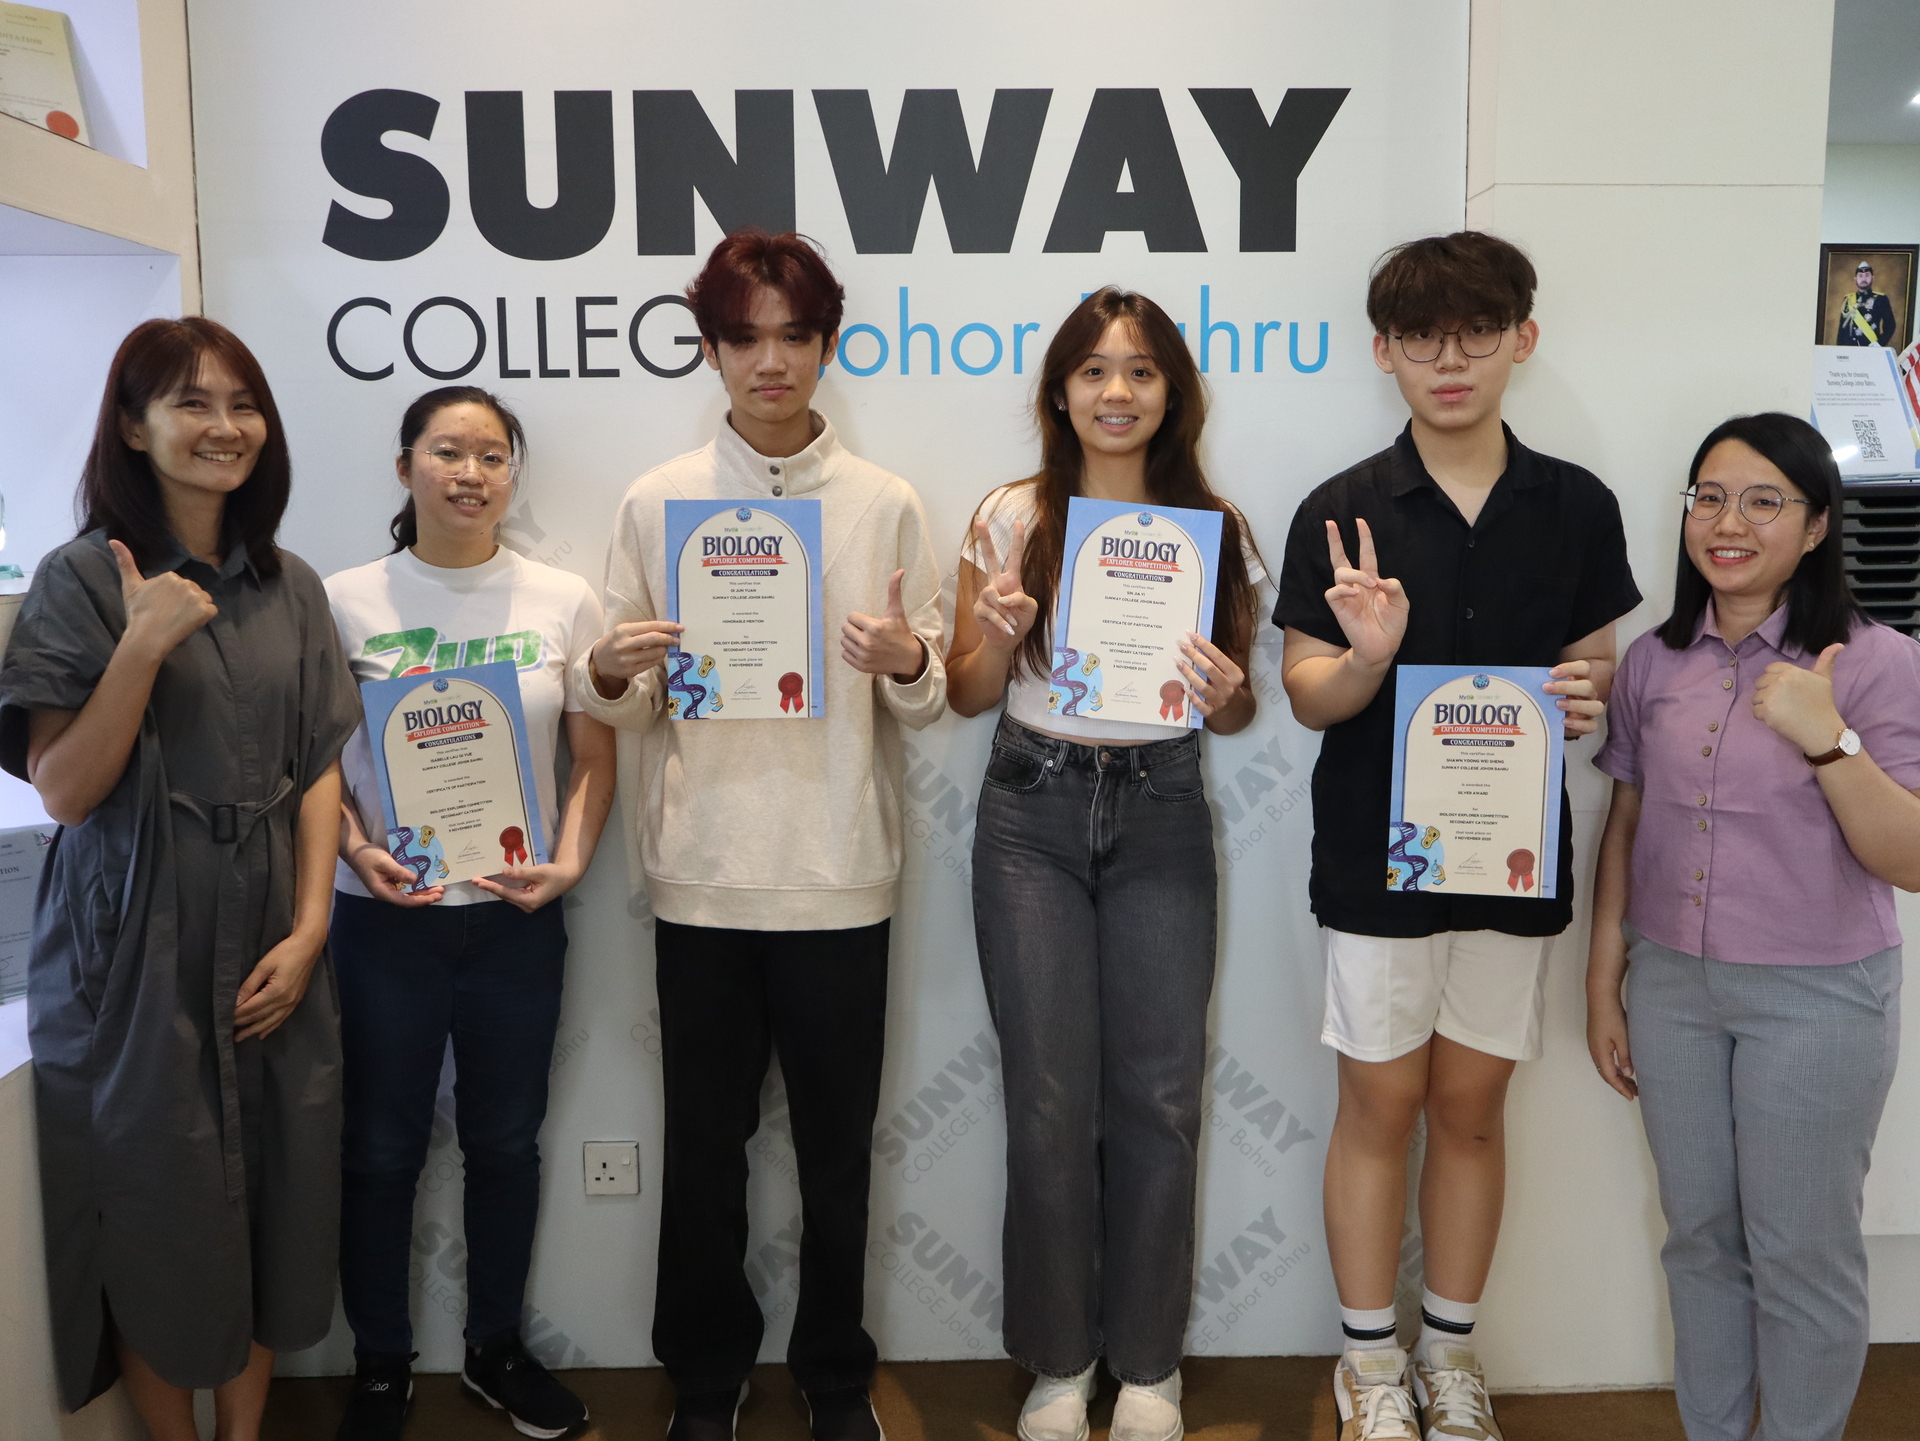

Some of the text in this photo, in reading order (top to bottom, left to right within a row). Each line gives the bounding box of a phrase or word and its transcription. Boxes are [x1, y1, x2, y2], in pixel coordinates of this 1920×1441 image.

[321, 88, 1352, 261] SUNWAY
[326, 294, 708, 380] COLLEG
[818, 287, 1041, 381] ohor
[702, 536, 783, 556] BIOLOGY
[1100, 536, 1181, 563] BIOLOGY
[1106, 558, 1173, 570] EXPLORER COMPETITION
[1114, 571, 1165, 582] CONGRATULATIONS
[402, 700, 483, 731] BIOLOGY
[414, 722, 480, 737] EXPLORER COMPETITION
[1434, 704, 1522, 726] BIOLOGY
[425, 734, 477, 747] CONGRATULATIONS
[1221, 773, 1311, 869] Johor Bahr
[872, 1031, 1001, 1167] SUNW
[902, 1107, 980, 1183] COLLEGE
[1229, 1128, 1276, 1177] Bahru
[868, 1241, 946, 1314] COLLEGE
[886, 1212, 1004, 1333] SUNW
[1217, 1242, 1310, 1332] Johor Bahru
